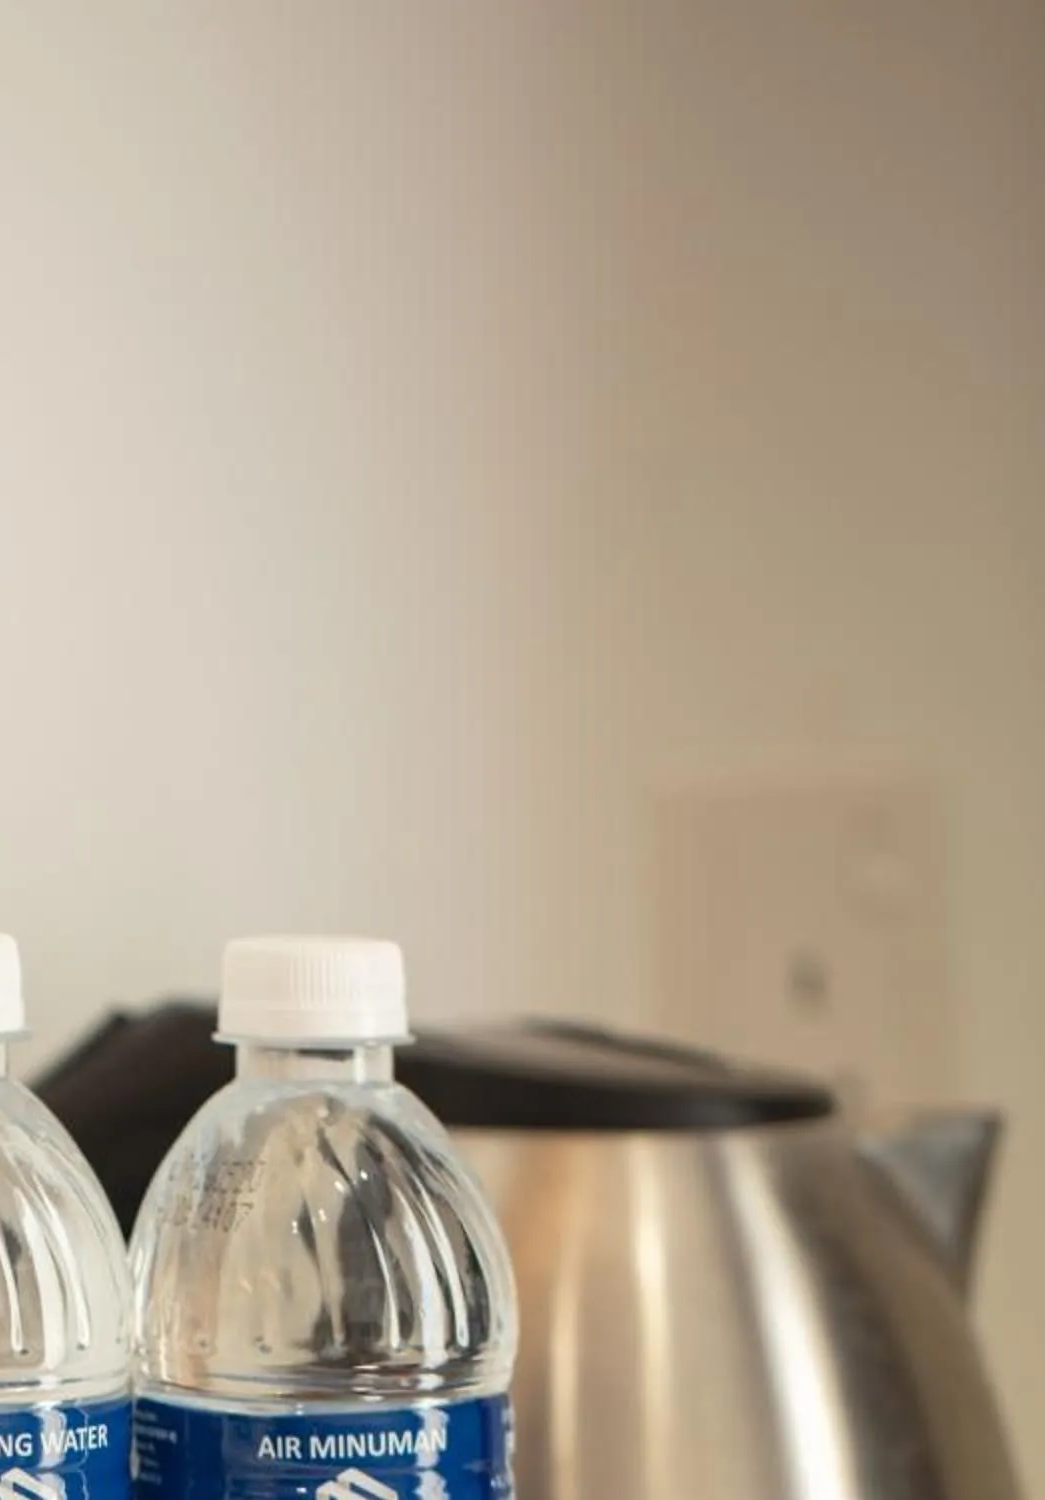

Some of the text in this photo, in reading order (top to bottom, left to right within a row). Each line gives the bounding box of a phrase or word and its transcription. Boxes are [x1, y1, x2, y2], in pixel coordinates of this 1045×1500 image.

[40, 1424, 109, 1456] WATER
[258, 1429, 448, 1460] AIR MINUMAN
